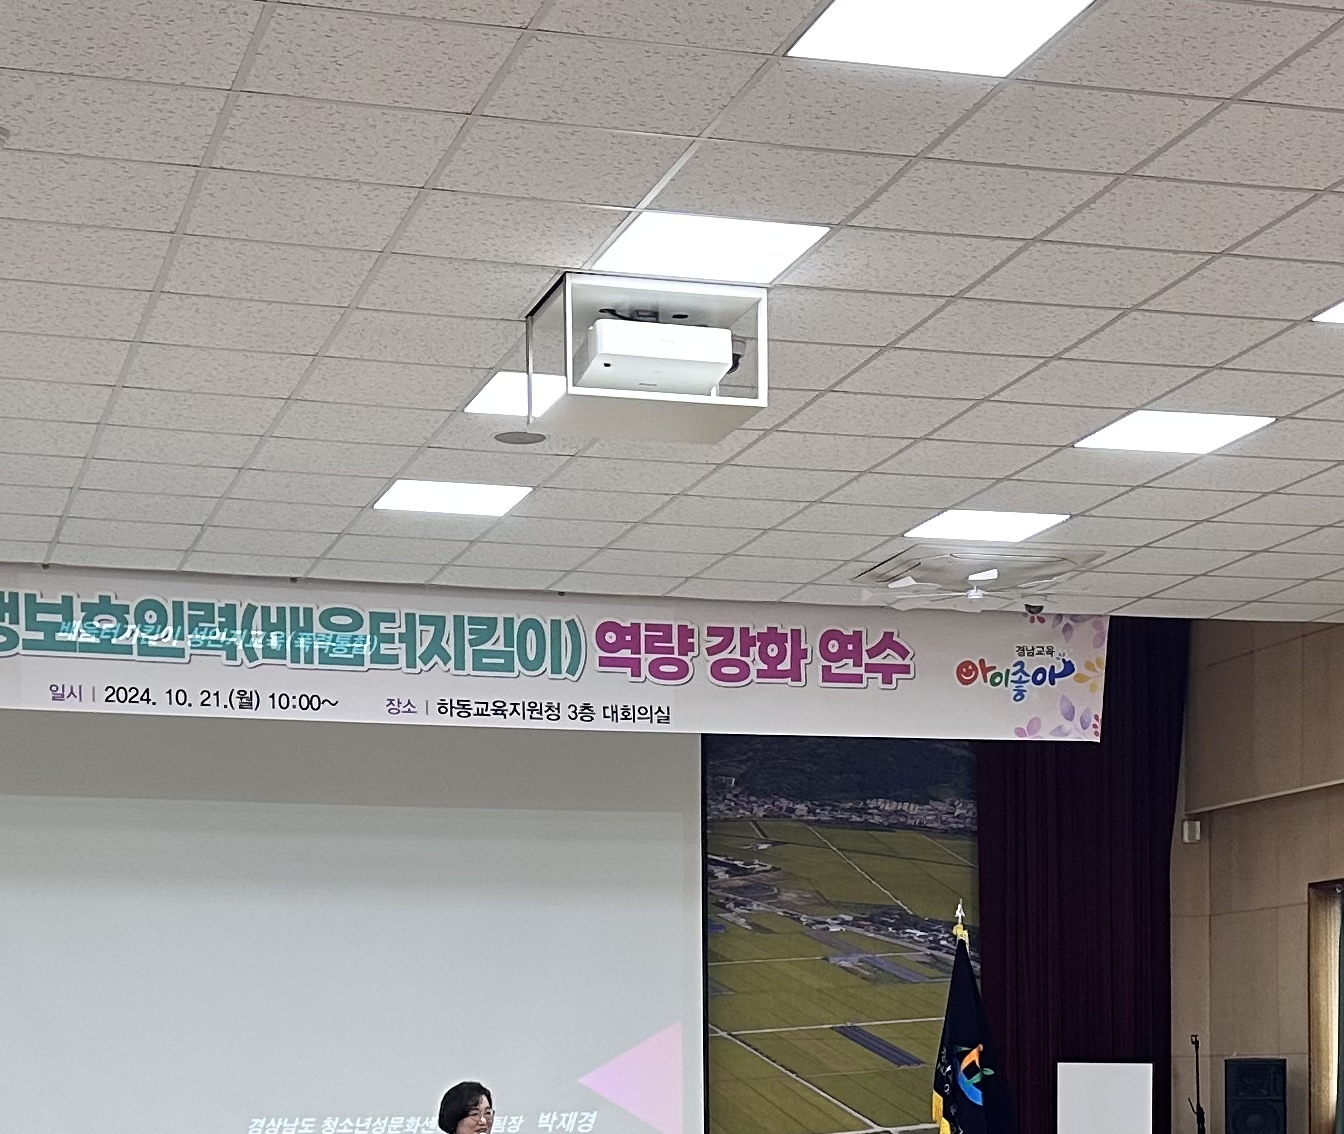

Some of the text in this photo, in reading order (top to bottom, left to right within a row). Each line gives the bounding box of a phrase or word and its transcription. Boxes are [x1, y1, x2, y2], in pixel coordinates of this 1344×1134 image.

[595, 619, 697, 683] 역량
[705, 624, 809, 685] 강화
[818, 627, 913, 686] 연수
[1015, 646, 1055, 657] 경남교육
[956, 658, 1076, 702] 아이좋아
[49, 684, 339, 711] 일시 2024. 10. 21.(월) 10:00~
[385, 698, 671, 725] 장소 하동교육지원청 3층 대회의실
[537, 1110, 597, 1134] 박재경
